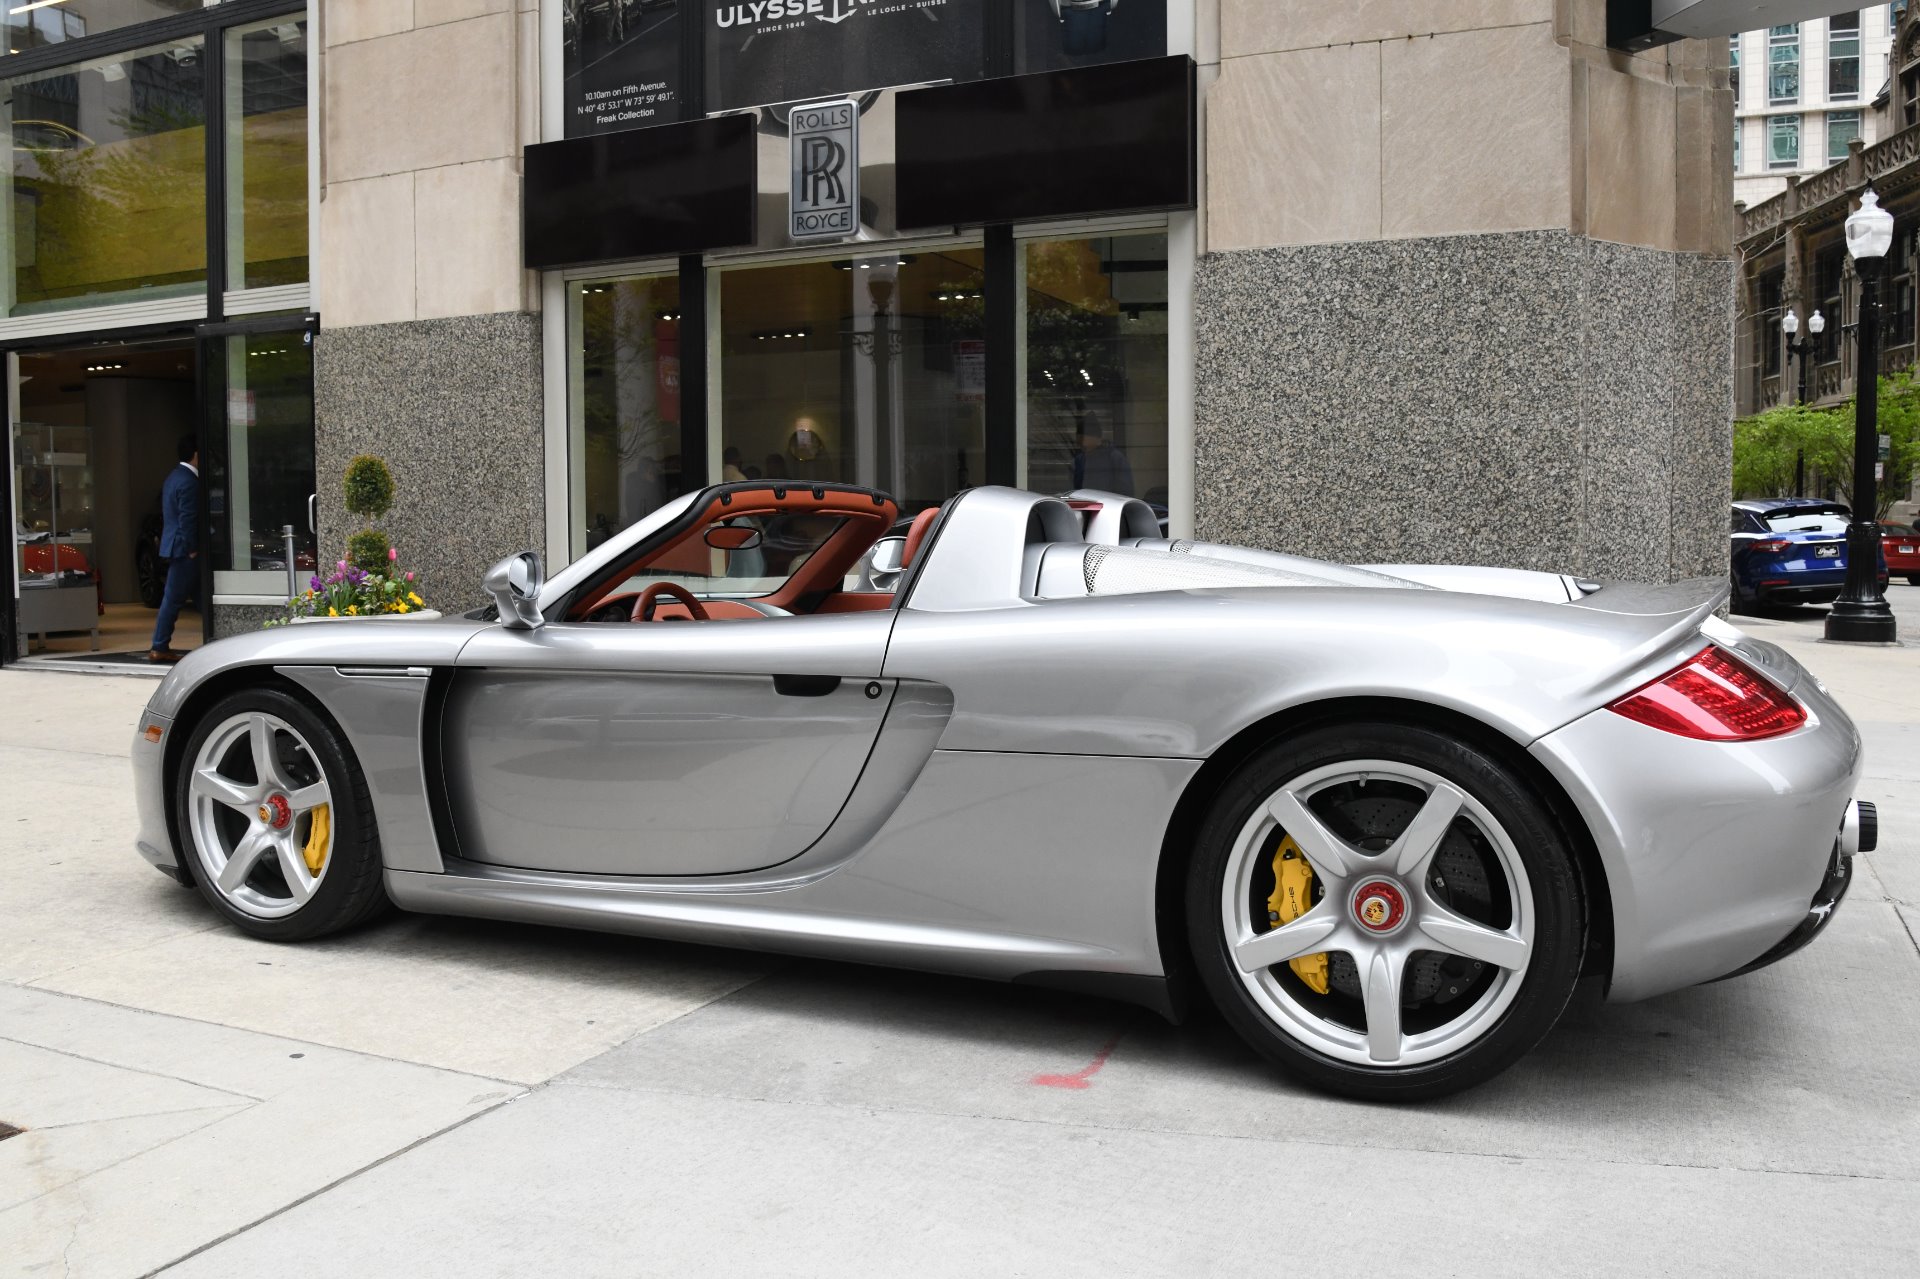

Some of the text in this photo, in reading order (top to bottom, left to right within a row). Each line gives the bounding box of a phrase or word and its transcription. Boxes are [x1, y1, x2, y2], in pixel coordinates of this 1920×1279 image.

[916, 0, 947, 8] SUISSE
[716, 0, 824, 28] ULYSSE
[757, 21, 805, 34] SINCE 1846
[612, 89, 621, 97] on
[623, 85, 638, 94] Fifth
[640, 81, 667, 92] Avenue.
[577, 106, 584, 115] N
[624, 98, 633, 107] W
[596, 108, 655, 124] Freak Collection
[796, 109, 848, 130] ROLLS
[796, 211, 849, 231] ROYCE
